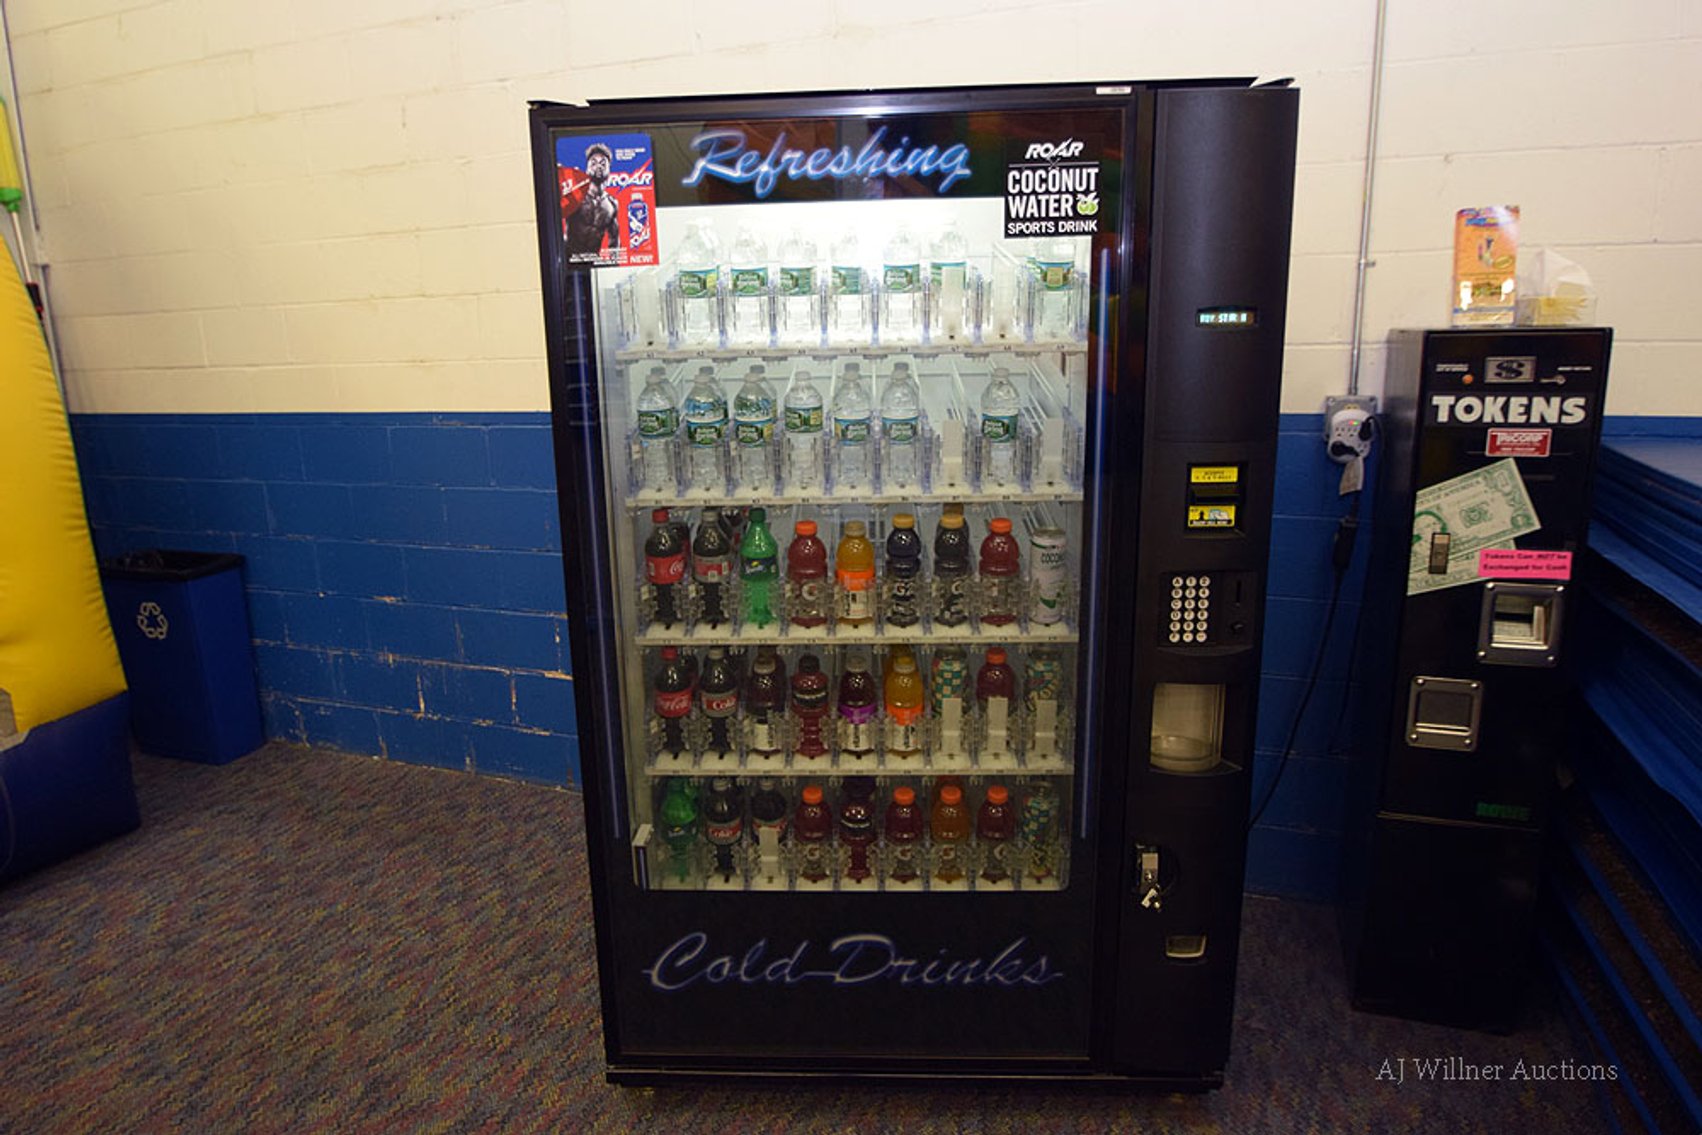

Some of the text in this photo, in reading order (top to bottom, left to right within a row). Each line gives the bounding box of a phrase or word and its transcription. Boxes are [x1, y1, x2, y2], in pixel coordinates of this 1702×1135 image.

[1025, 138, 1084, 159] ROAR
[681, 125, 973, 199] Refreshing
[606, 166, 653, 190] ROAR
[1007, 168, 1099, 194] COCONUT
[1008, 194, 1074, 219] WATER
[1007, 219, 1098, 235] SPORTS DRINK
[630, 254, 654, 264] NEW!
[1432, 395, 1586, 424] TOKENS
[642, 932, 1064, 991] Cold Drinks
